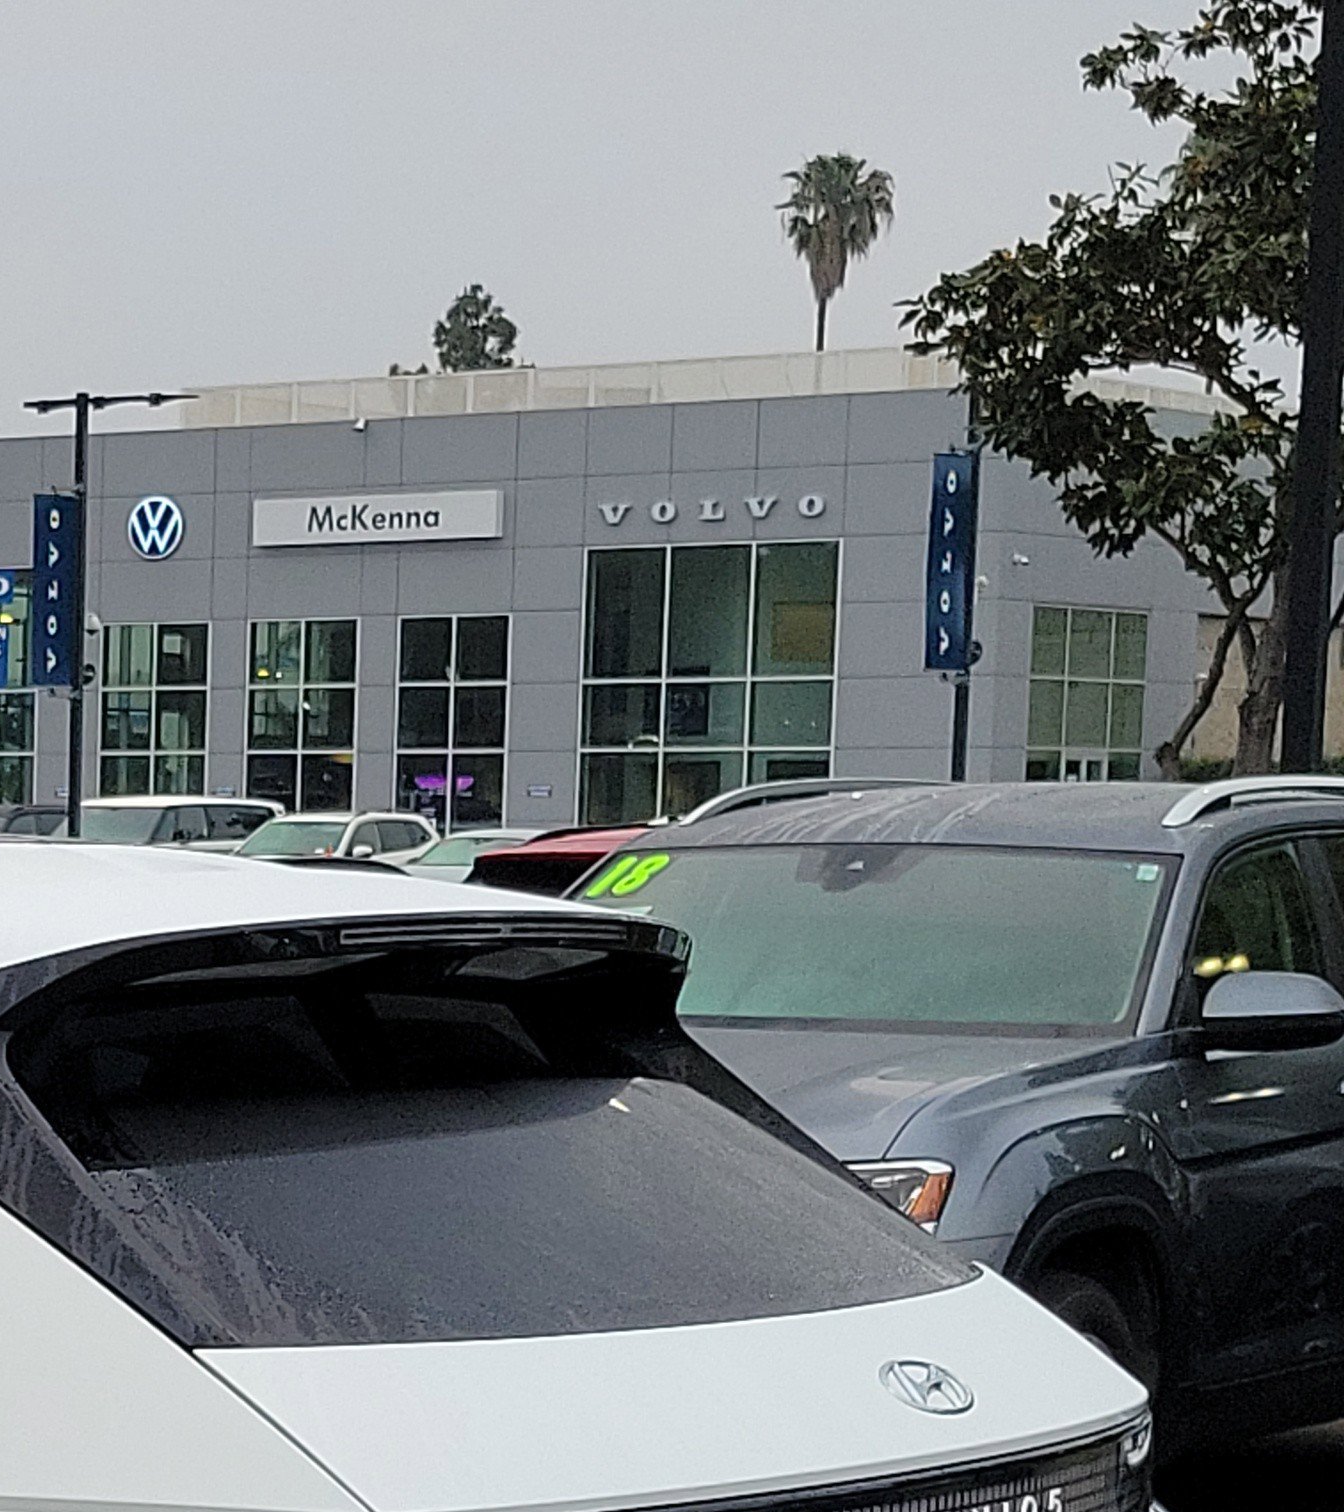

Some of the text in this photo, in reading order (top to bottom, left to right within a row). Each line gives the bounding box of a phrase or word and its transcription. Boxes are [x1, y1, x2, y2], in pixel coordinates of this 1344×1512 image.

[307, 504, 441, 533] McKenna
[598, 495, 827, 525] VOLVO
[938, 469, 958, 656] VOLVO
[586, 853, 670, 898] 18
